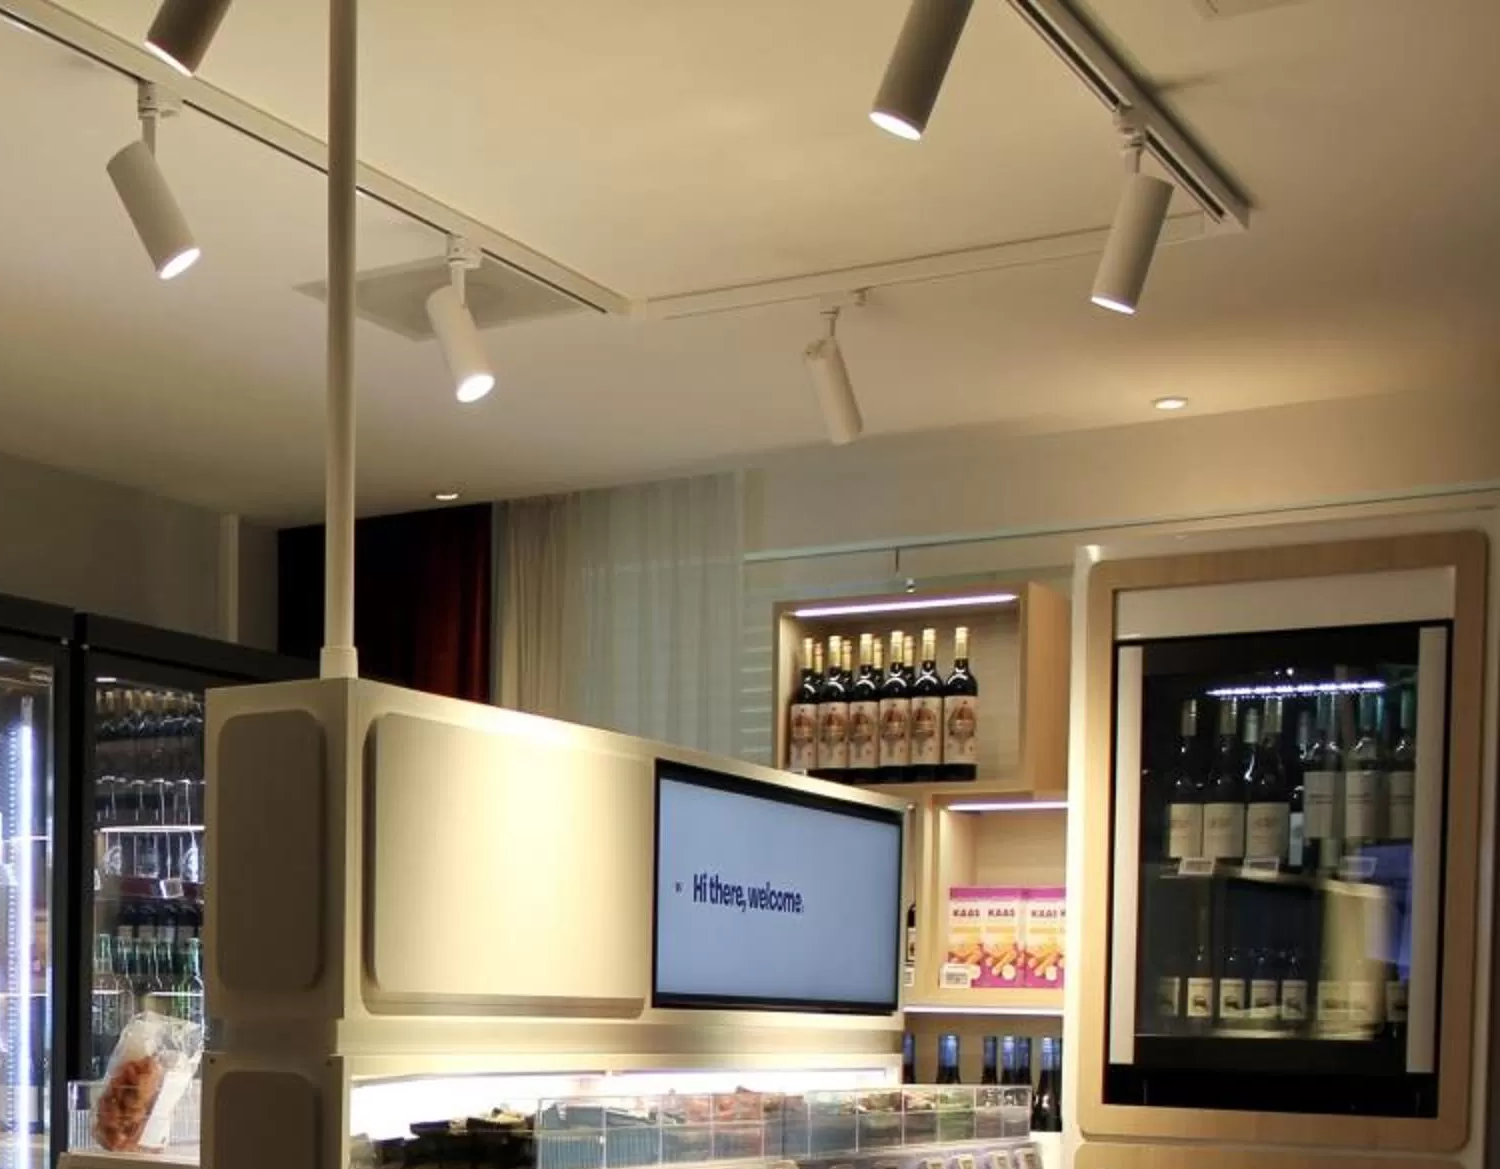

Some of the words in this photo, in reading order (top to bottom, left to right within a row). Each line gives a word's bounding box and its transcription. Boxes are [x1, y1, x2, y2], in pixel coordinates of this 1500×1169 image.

[693, 873, 707, 903] Hi
[709, 876, 747, 912] there,
[747, 881, 805, 914] welcome.
[952, 908, 980, 918] KAAS
[987, 908, 1016, 918] KAAS
